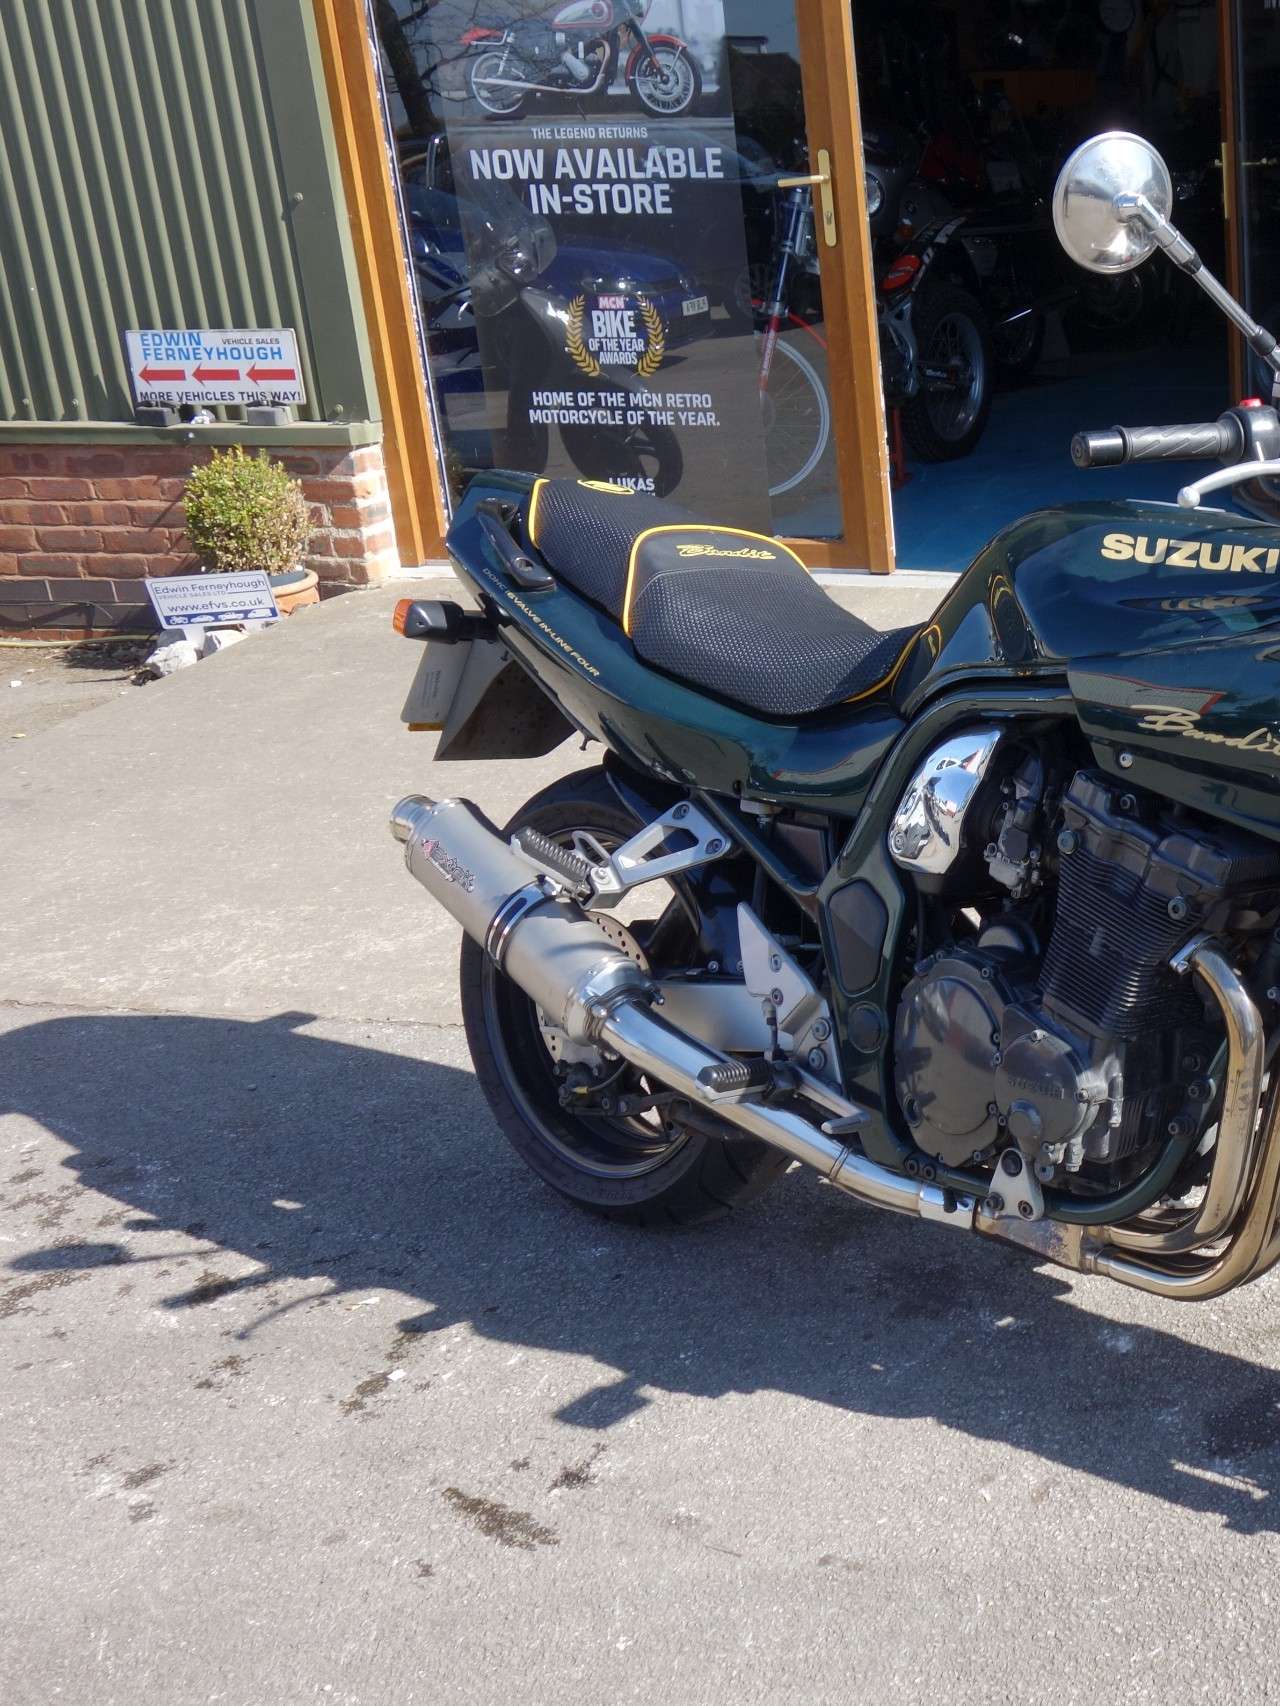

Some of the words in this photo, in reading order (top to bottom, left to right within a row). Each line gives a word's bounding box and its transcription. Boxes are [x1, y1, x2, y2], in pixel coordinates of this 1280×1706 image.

[531, 127, 552, 139] THE
[554, 127, 596, 139] LEGEND
[598, 127, 648, 139] RETURNS
[469, 149, 544, 180] NOW
[555, 147, 725, 180] AVAILABLE
[529, 183, 673, 215] IN-STORE
[599, 296, 625, 309] MCN
[591, 310, 636, 338] BIKE
[140, 333, 201, 346] EDWIN
[588, 339, 600, 351] OF
[601, 339, 620, 351] THE
[620, 339, 645, 352] YEAR
[143, 347, 283, 361] FERNEYHOUGH
[599, 352, 638, 365] AWARDS
[140, 392, 173, 401] MORE
[176, 392, 236, 401] VEHICLES
[238, 392, 267, 401] THIS
[271, 391, 301, 401] WAY!
[532, 391, 573, 407] HOME
[577, 392, 596, 407] OF
[597, 392, 625, 407] THE
[629, 393, 663, 408] MCN
[666, 394, 712, 408] RETRO
[528, 409, 624, 425] MOTORCYCLE
[626, 411, 645, 425] OF
[648, 410, 676, 425] THE
[678, 411, 721, 426] YEAR.
[608, 476, 655, 491] LUKAS
[675, 543, 777, 561] Bandit
[1100, 533, 1280, 575] SUZUKI
[154, 583, 190, 594] Edwin
[191, 579, 266, 592] Ferneyhough
[168, 599, 265, 613] www.efvs.co.uk
[539, 622, 574, 652] IN-LINE
[570, 651, 600, 677] FOUR
